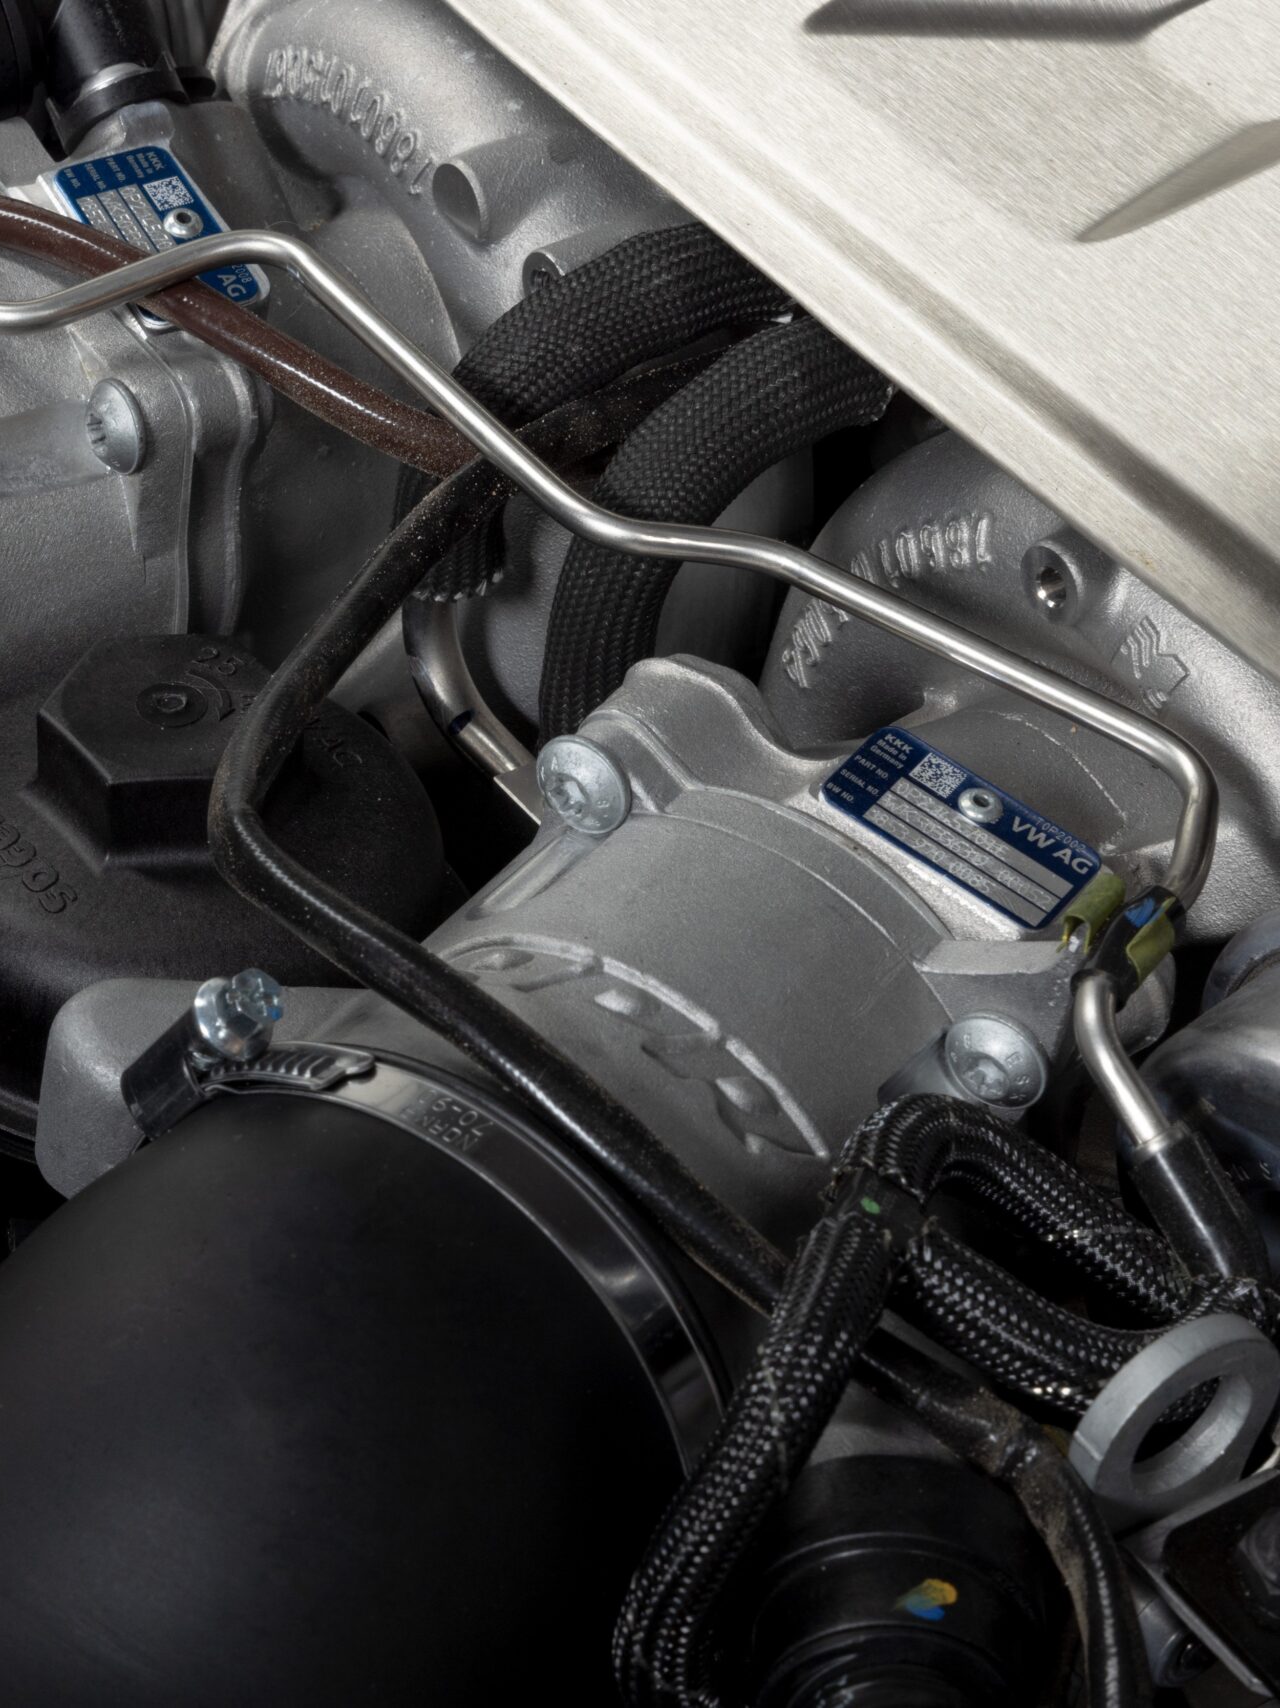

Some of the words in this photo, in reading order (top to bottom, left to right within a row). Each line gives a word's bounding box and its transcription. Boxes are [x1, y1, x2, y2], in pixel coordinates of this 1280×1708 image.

[147, 152, 164, 170] KKK
[218, 273, 247, 298] AG
[876, 739, 899, 757] Made
[896, 751, 908, 762] in
[884, 733, 913, 754] KKK
[854, 754, 876, 771] PART
[874, 766, 889, 781] NO.
[870, 745, 904, 770] Germany
[840, 768, 866, 788] SERIAL
[866, 783, 881, 797] NO.
[1011, 815, 1055, 849] VW
[1052, 847, 1094, 875] AG
